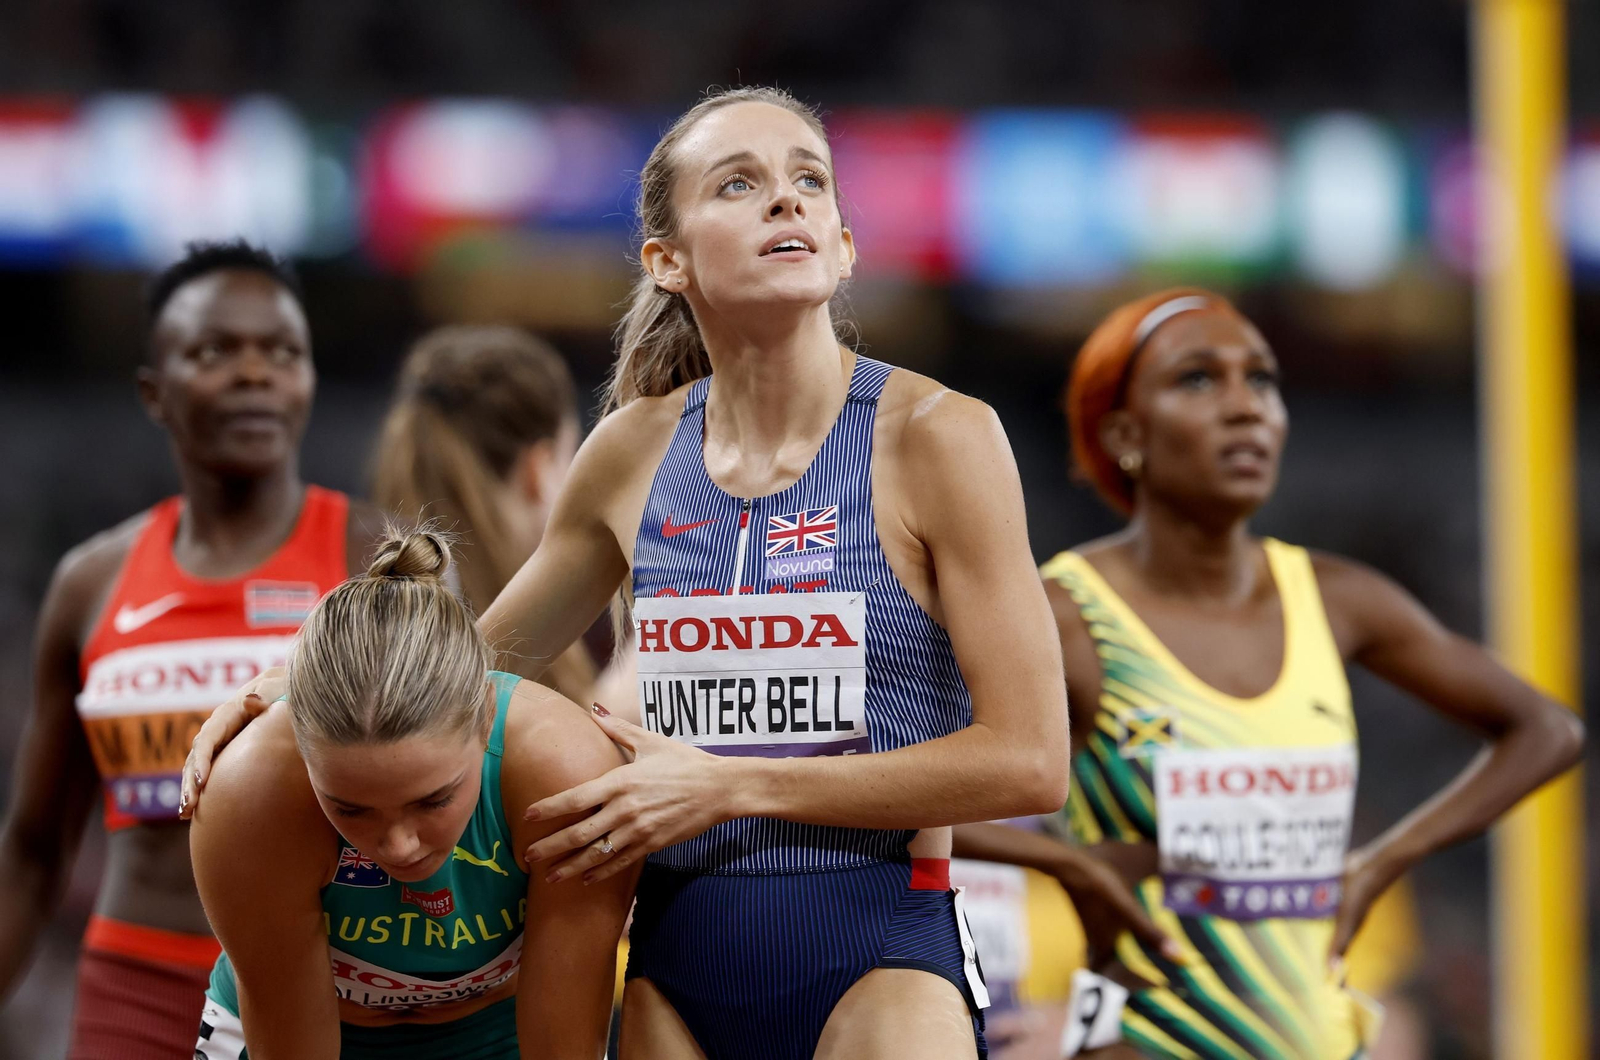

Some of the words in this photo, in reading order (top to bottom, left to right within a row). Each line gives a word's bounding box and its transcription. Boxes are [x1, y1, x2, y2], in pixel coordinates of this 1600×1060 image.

[767, 558, 833, 578] Novuna
[638, 614, 859, 652] HONDA
[96, 656, 286, 696] HOND
[643, 677, 757, 738] HUNTER
[766, 675, 855, 734] BELL
[1169, 762, 1355, 797] HOND
[333, 948, 521, 992] HOND
